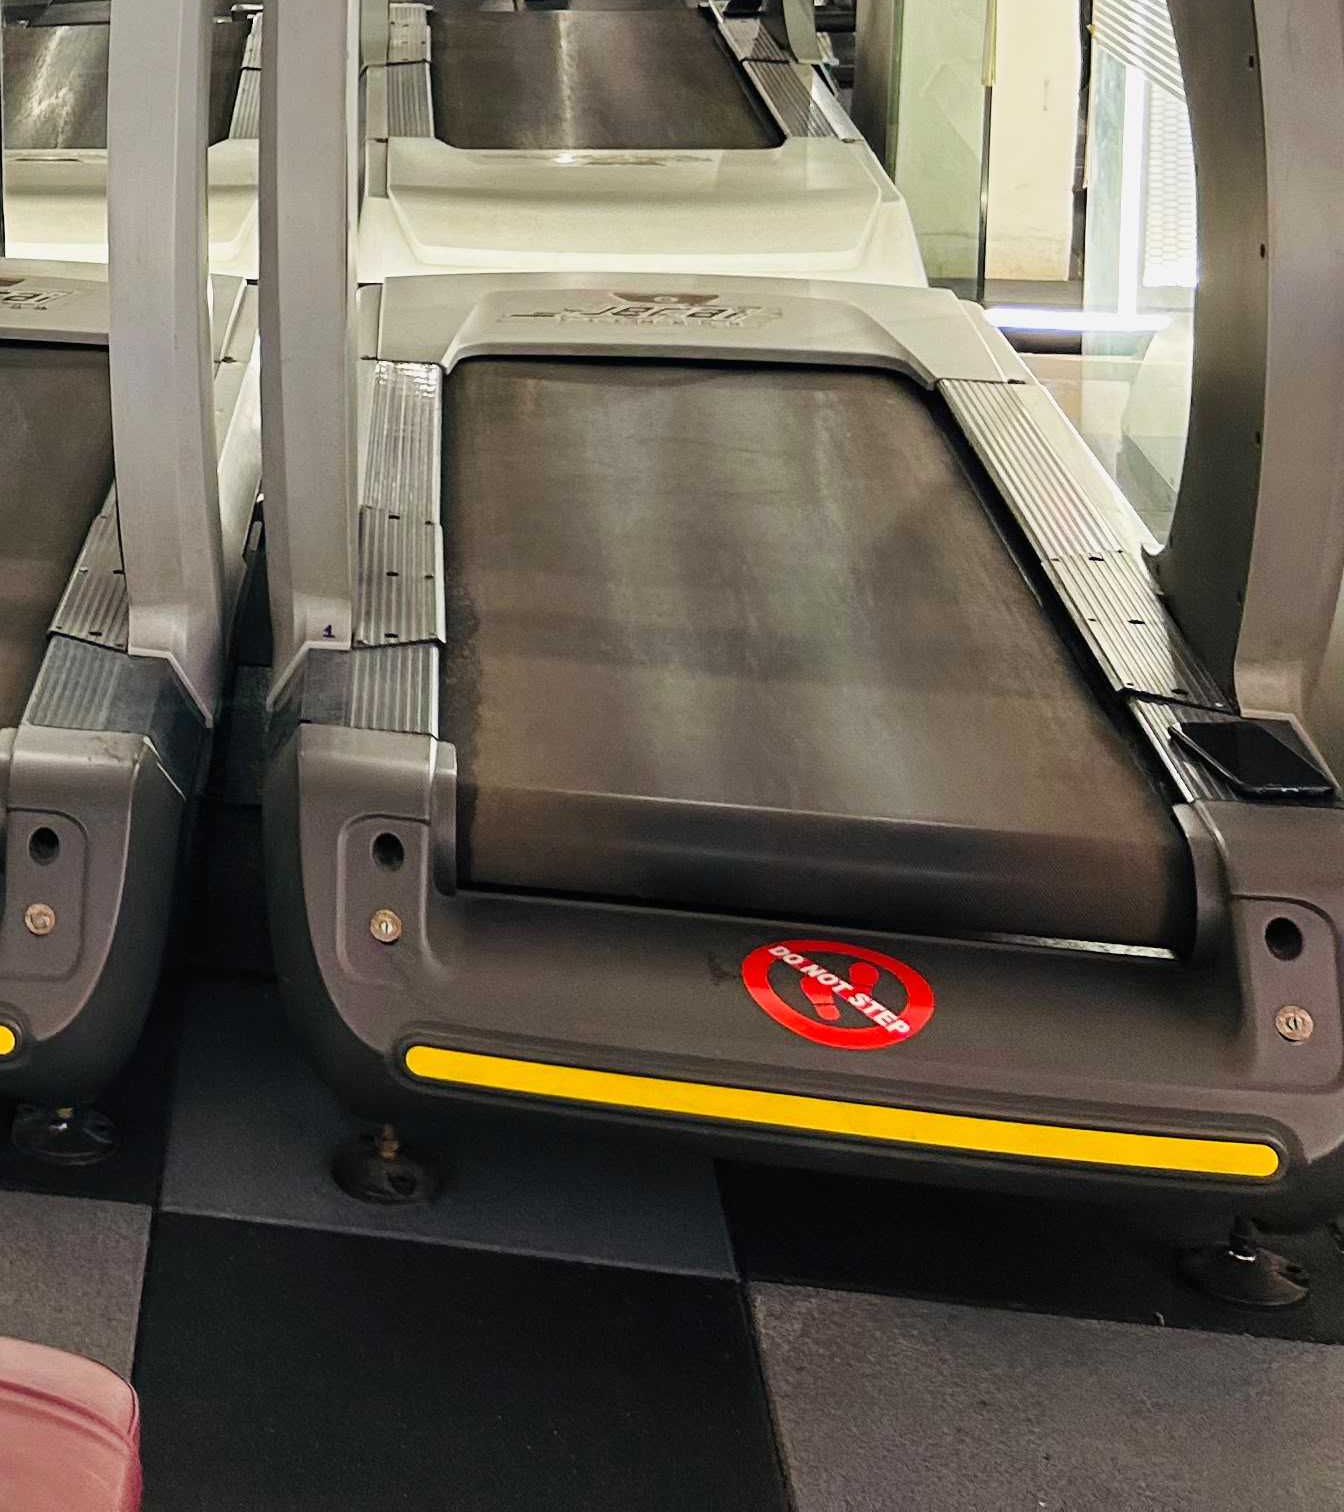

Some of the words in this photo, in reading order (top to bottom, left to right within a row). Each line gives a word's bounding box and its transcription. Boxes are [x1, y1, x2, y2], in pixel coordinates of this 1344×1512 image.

[768, 945, 804, 965] DO
[800, 963, 855, 994] NOT
[849, 992, 911, 1034] STEP
